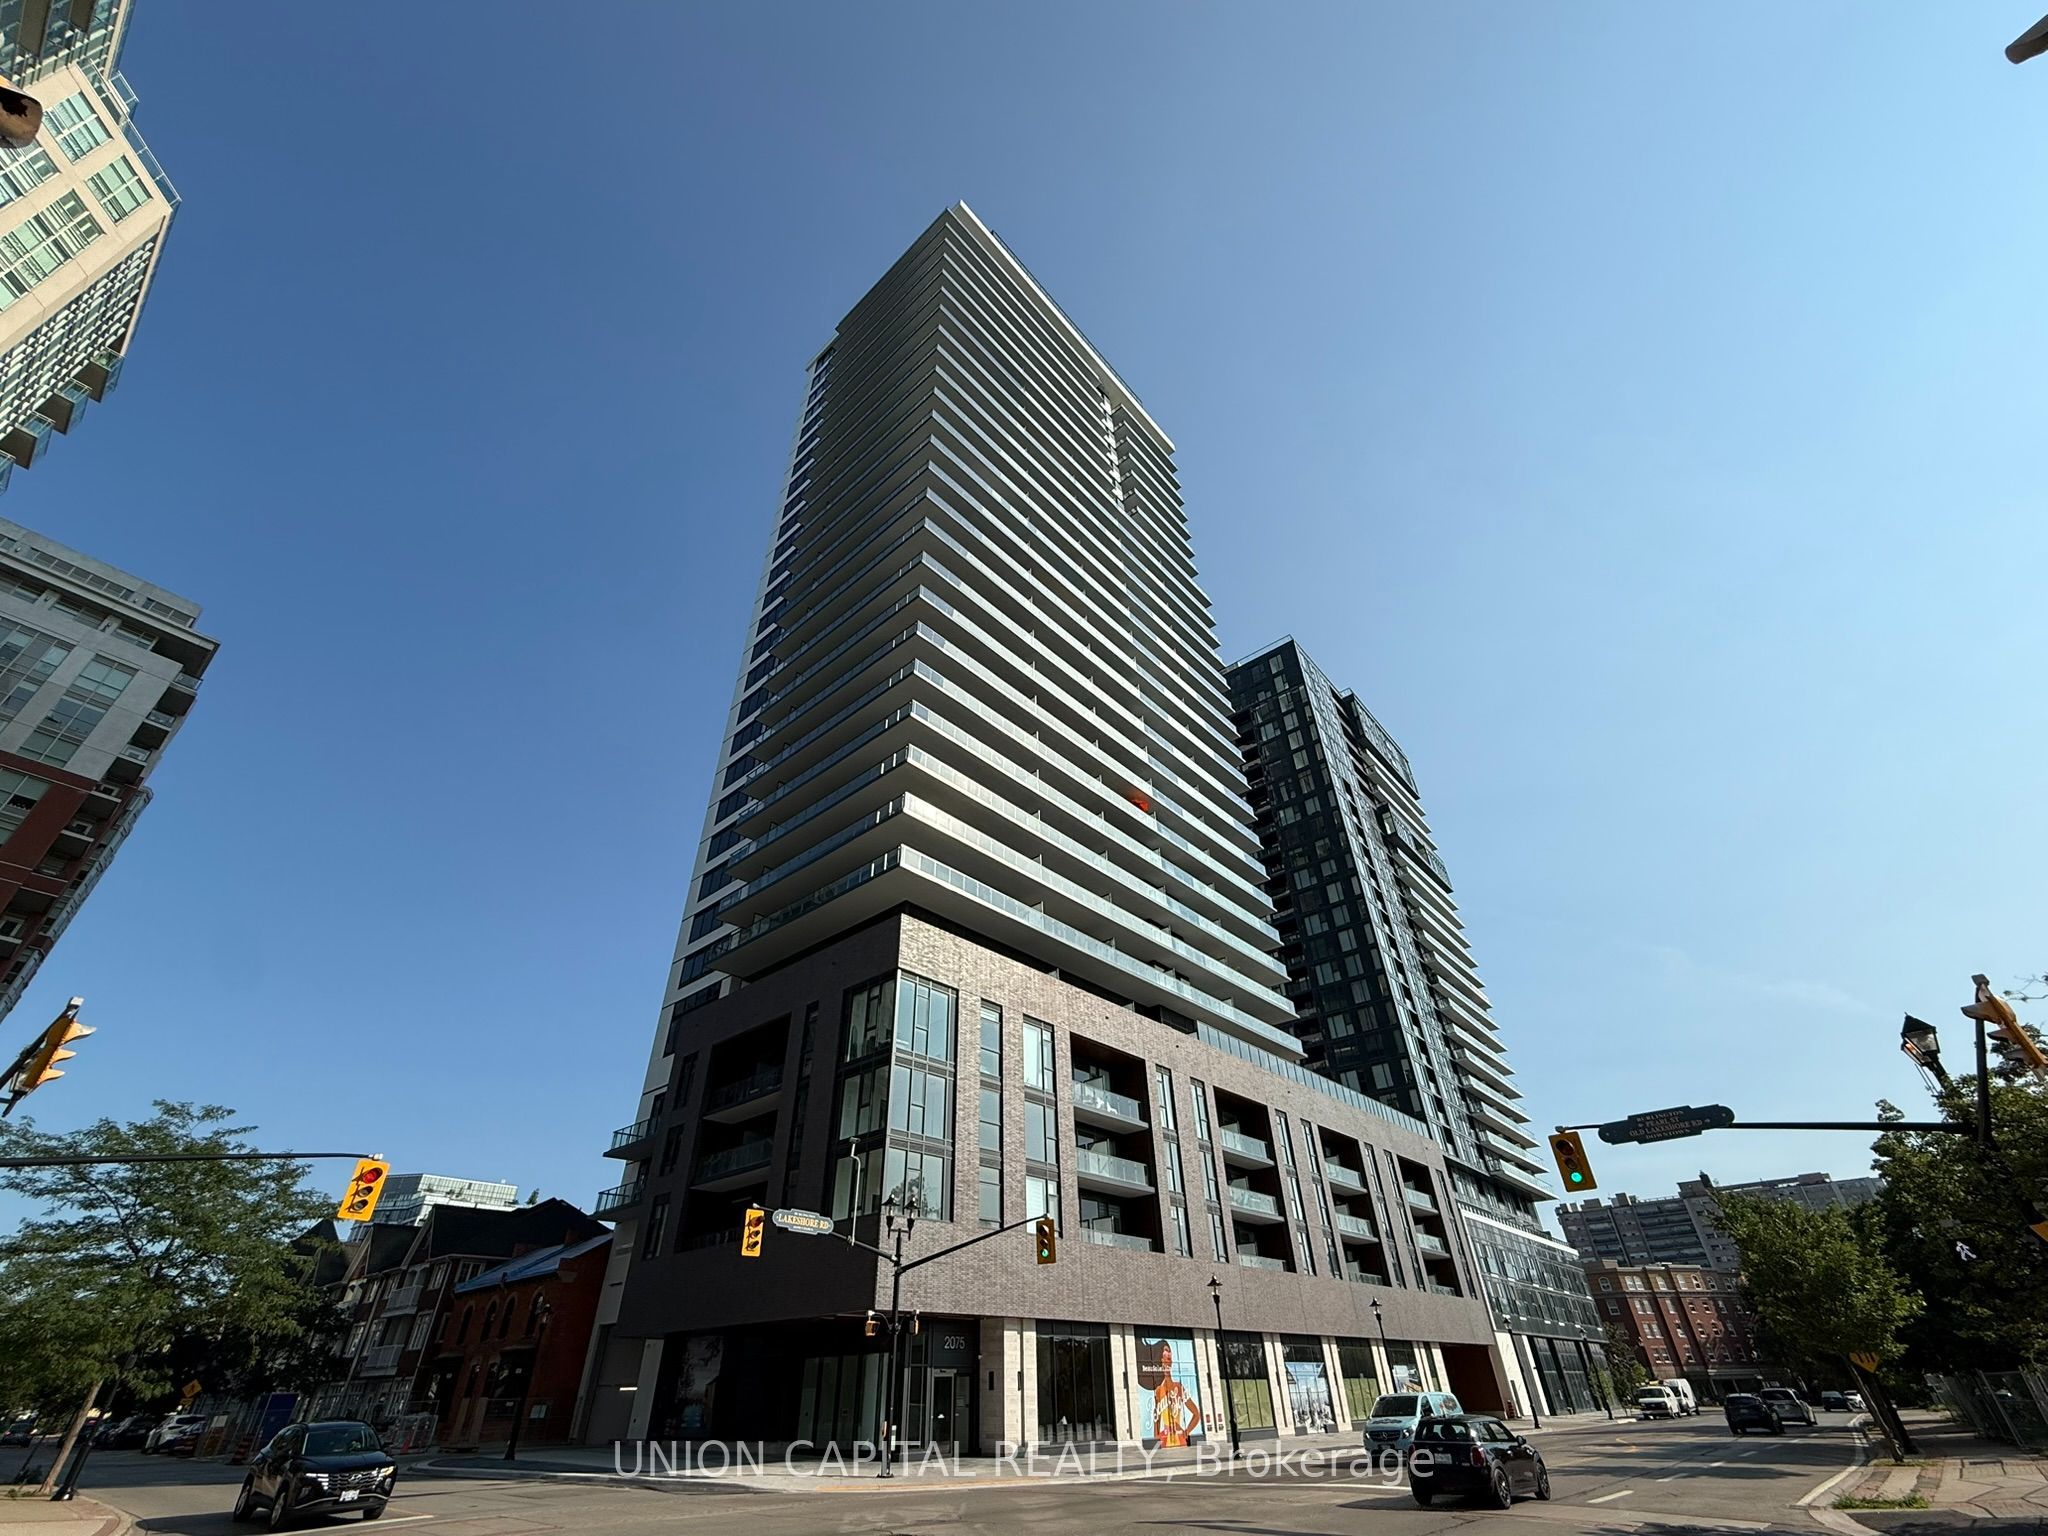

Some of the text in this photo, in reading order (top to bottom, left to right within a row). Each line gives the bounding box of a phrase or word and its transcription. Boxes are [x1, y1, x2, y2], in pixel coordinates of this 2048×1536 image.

[1629, 1118, 1703, 1137] OLD LAKESHORE RD
[1645, 1116, 1680, 1127] PEARL ST
[1645, 1129, 1691, 1139] DOWNTOWN
[778, 1213, 819, 1228] LAKESHORE
[820, 1220, 829, 1229] RD
[944, 1335, 965, 1349] 2075
